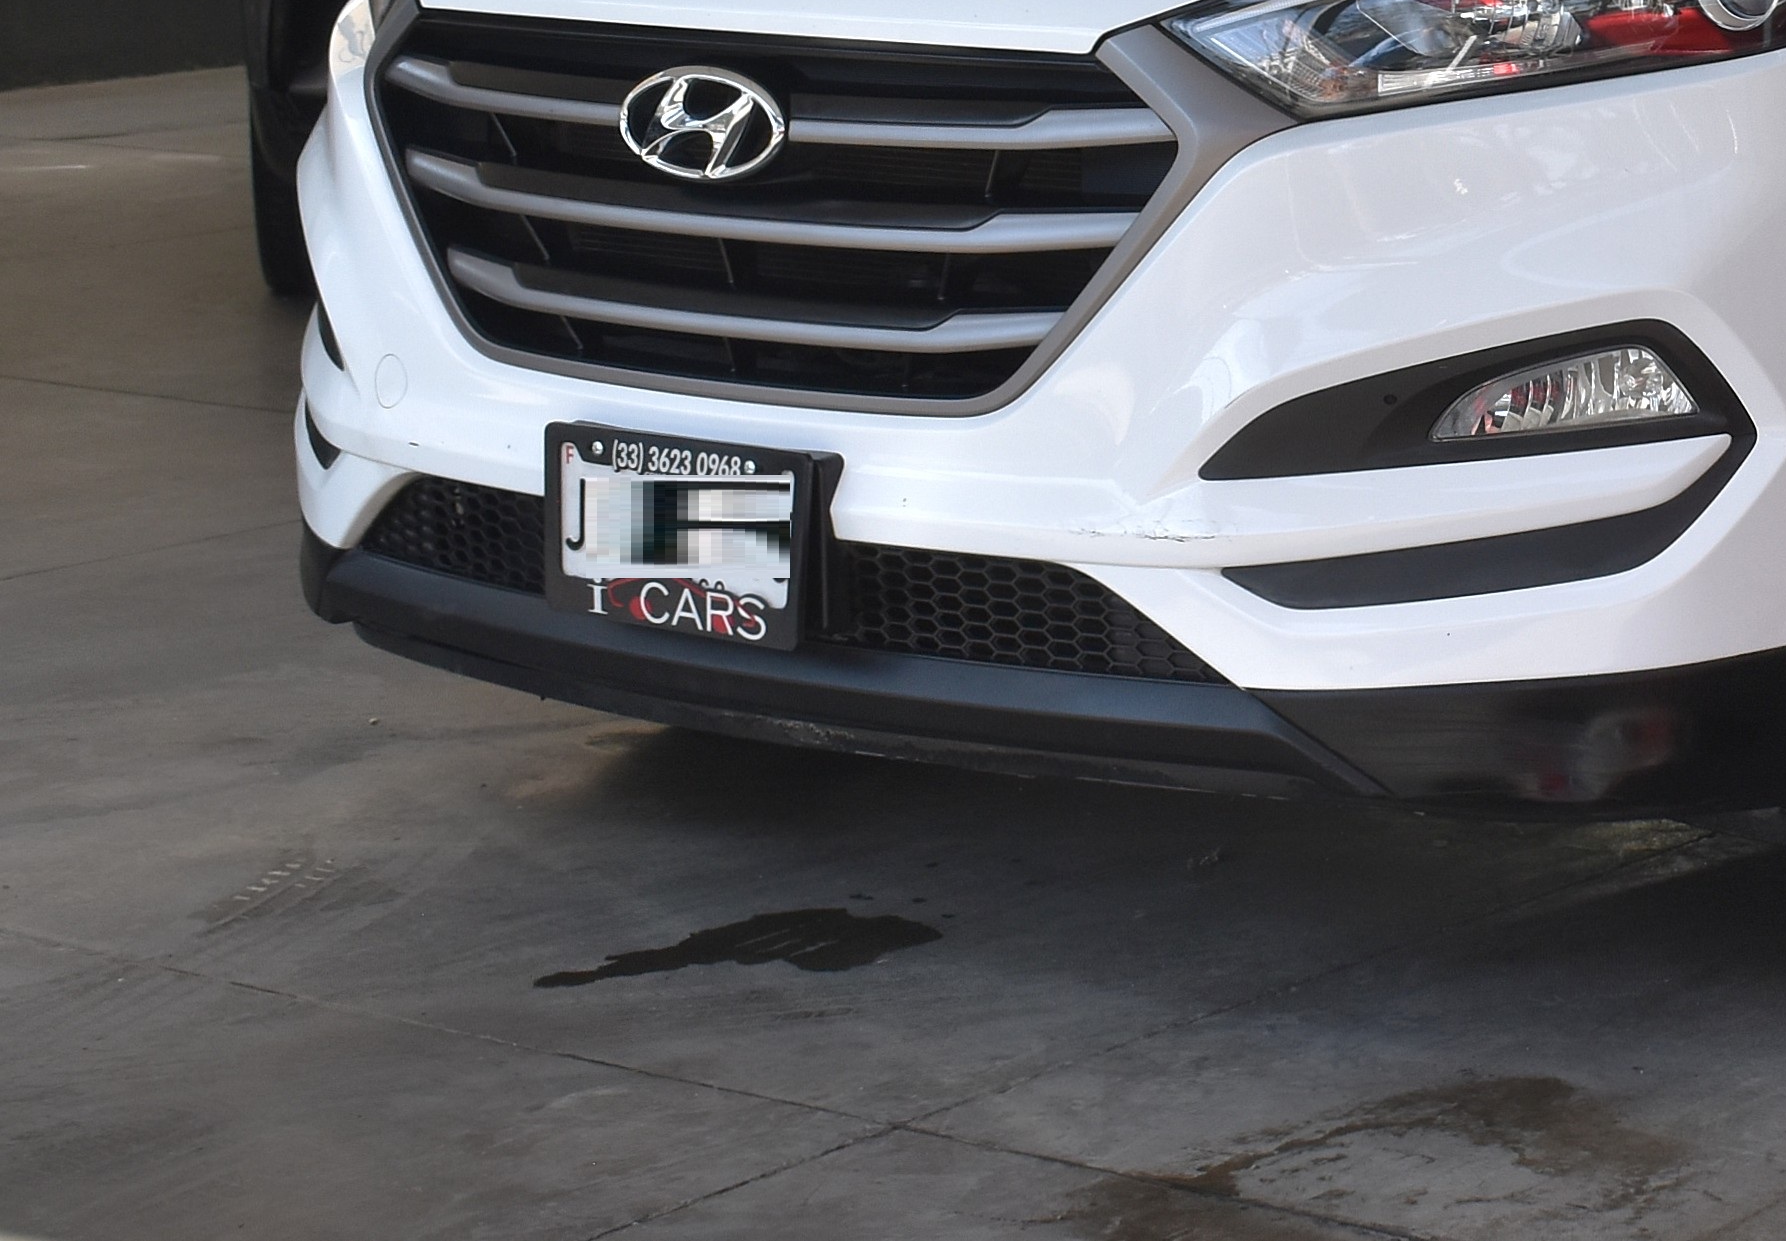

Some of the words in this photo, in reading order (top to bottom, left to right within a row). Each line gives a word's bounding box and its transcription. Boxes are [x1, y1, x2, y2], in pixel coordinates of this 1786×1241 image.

[612, 439, 644, 473] (33)
[648, 446, 692, 475] 3623
[696, 452, 741, 475] 0968
[640, 582, 767, 640] CARS
